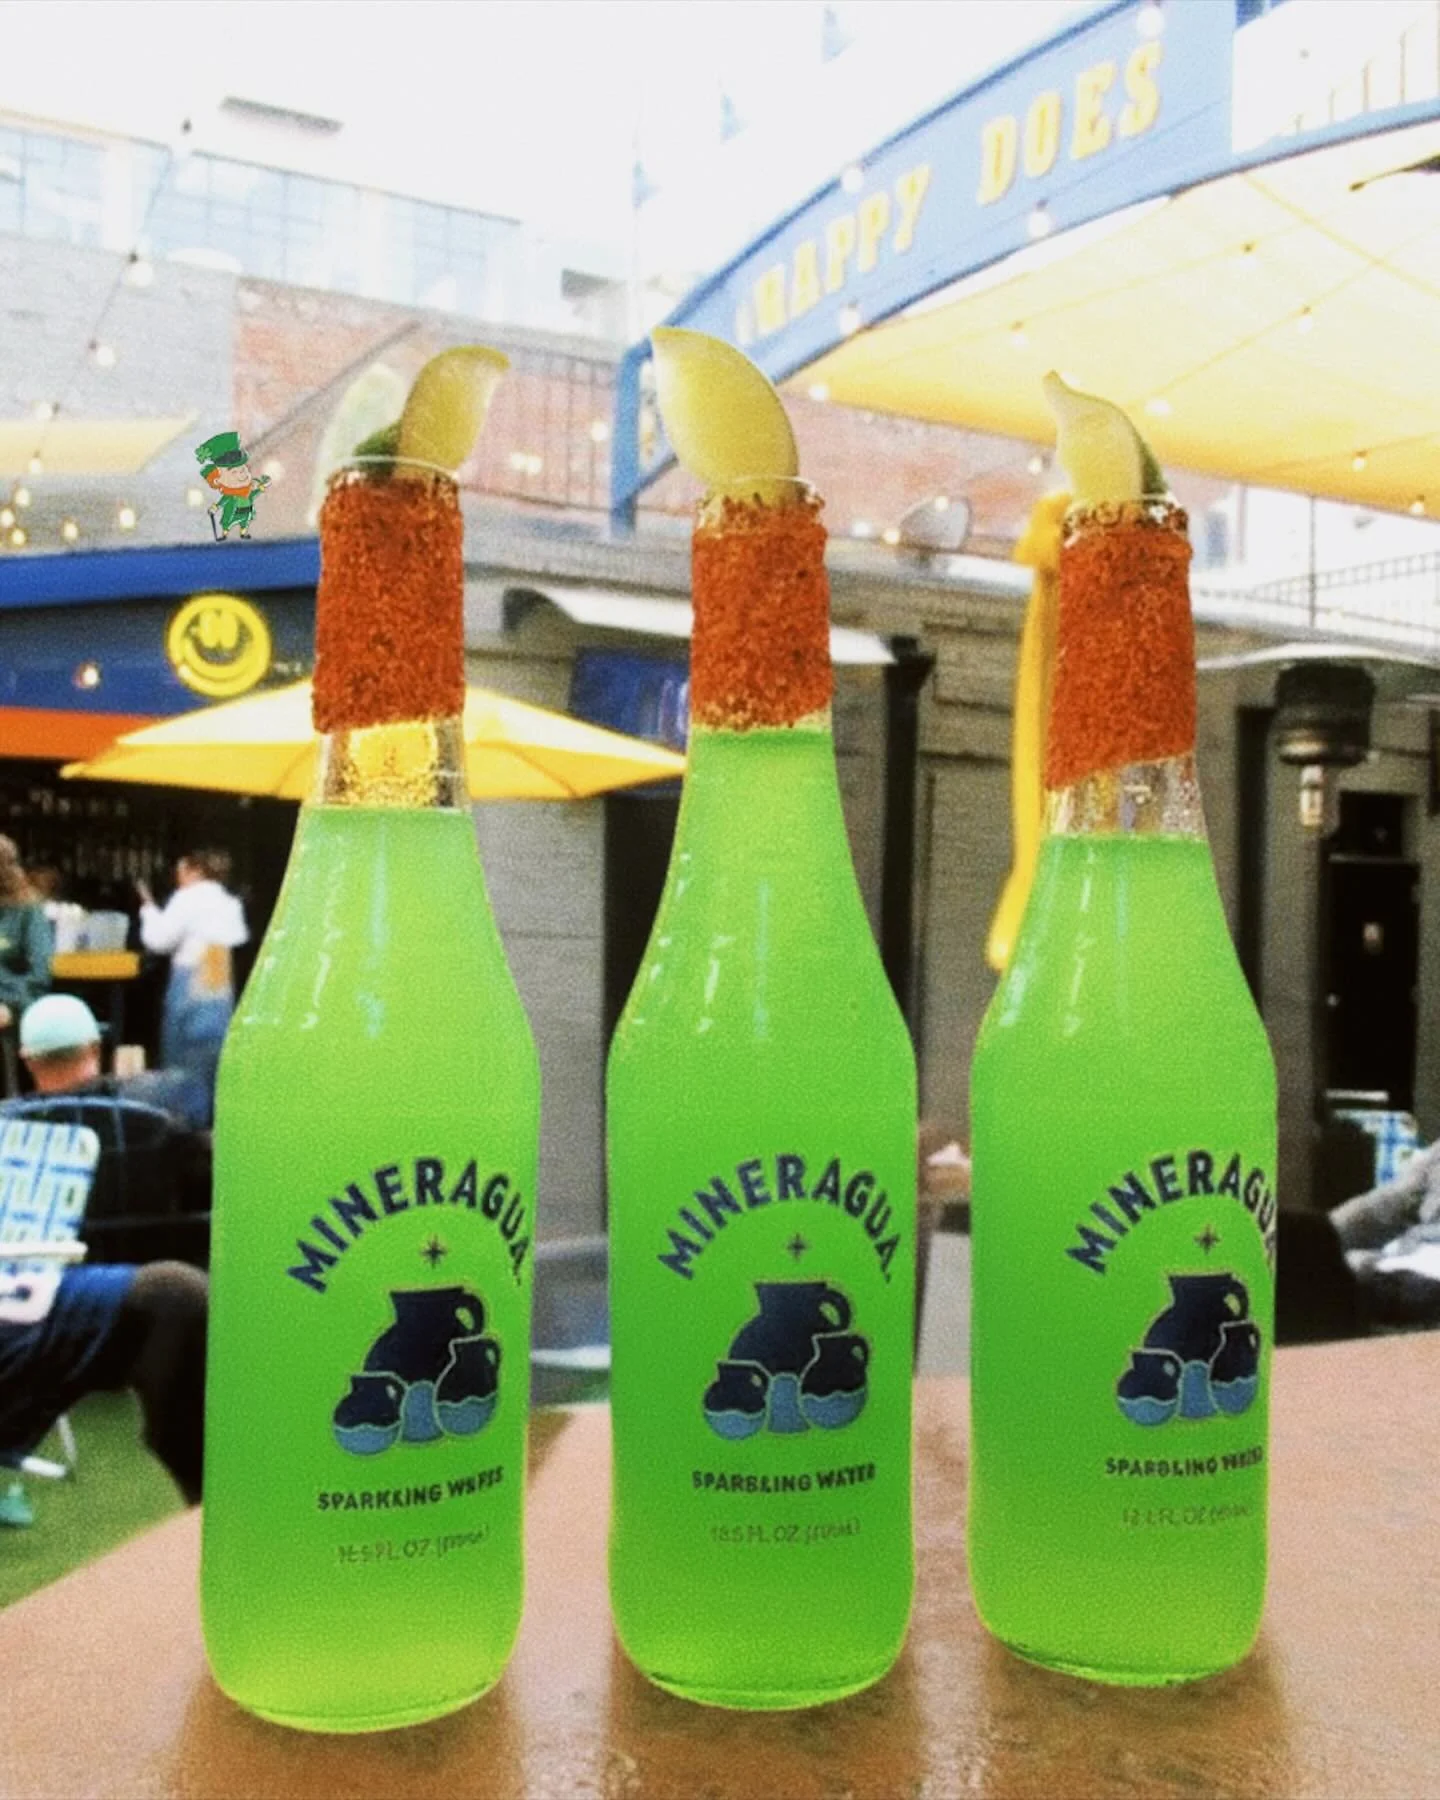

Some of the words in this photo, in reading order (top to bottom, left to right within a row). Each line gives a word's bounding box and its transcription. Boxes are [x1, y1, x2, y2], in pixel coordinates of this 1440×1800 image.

[976, 39, 1165, 207] DOES
[286, 1157, 530, 1294] MINERAGUA
[656, 1153, 901, 1284] MINERAGUA
